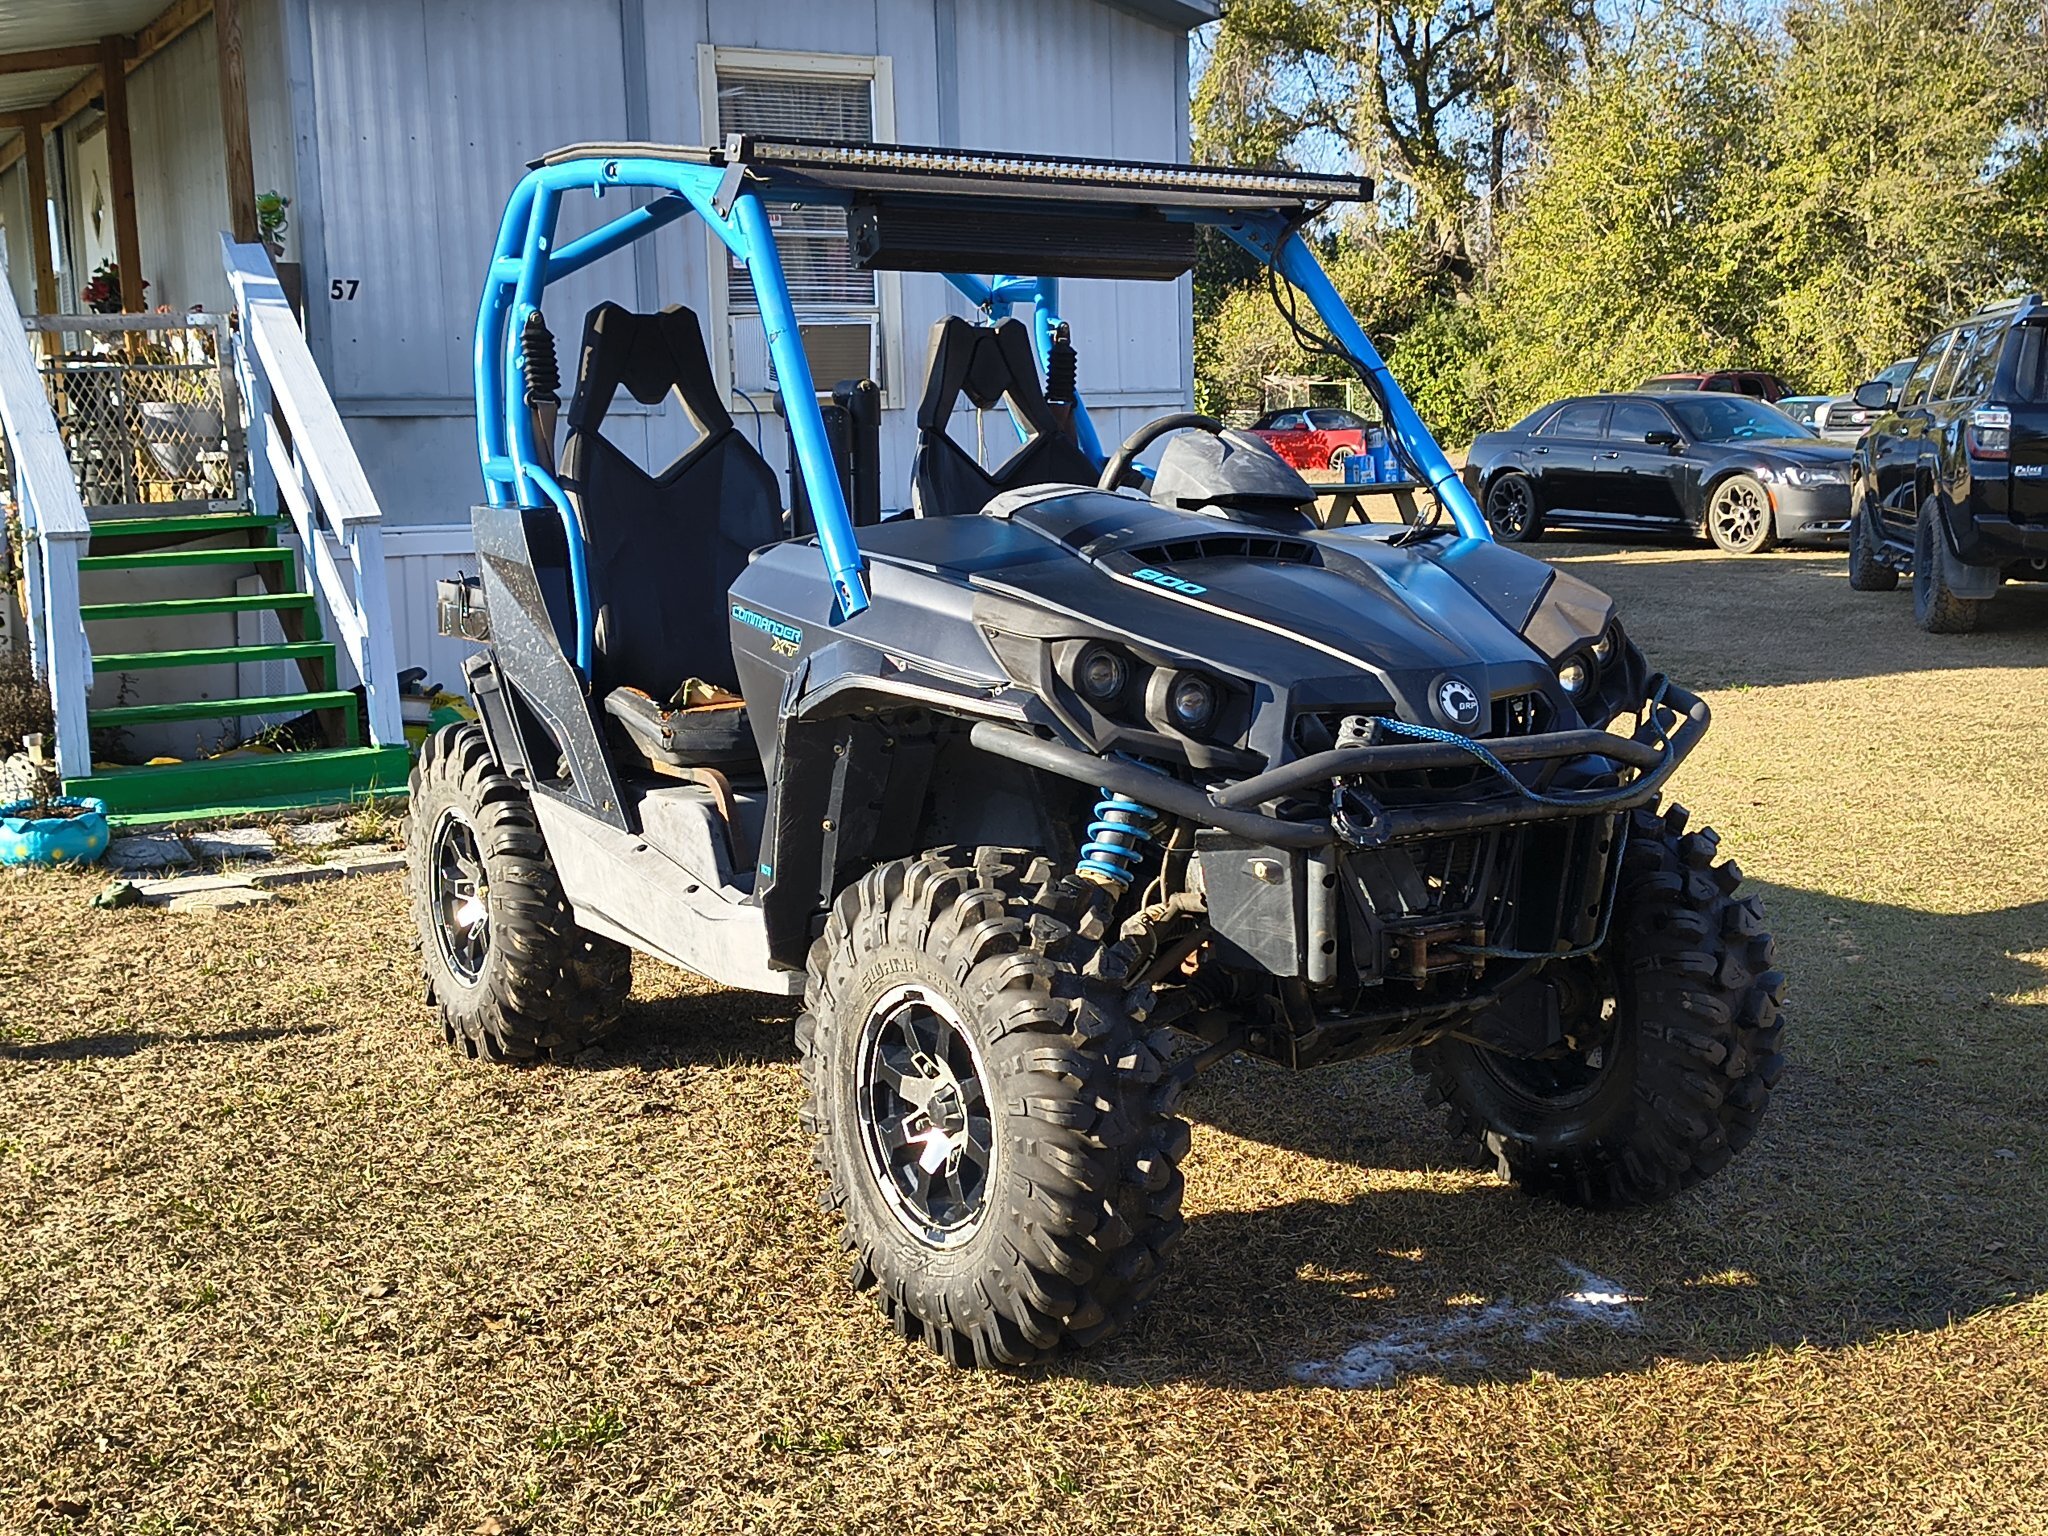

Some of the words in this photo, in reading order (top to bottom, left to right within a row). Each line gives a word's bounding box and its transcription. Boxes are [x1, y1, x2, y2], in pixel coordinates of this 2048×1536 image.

[331, 279, 360, 301] 57
[1132, 568, 1208, 595] 800
[732, 605, 802, 643] COMMANDER
[771, 635, 799, 658] XT
